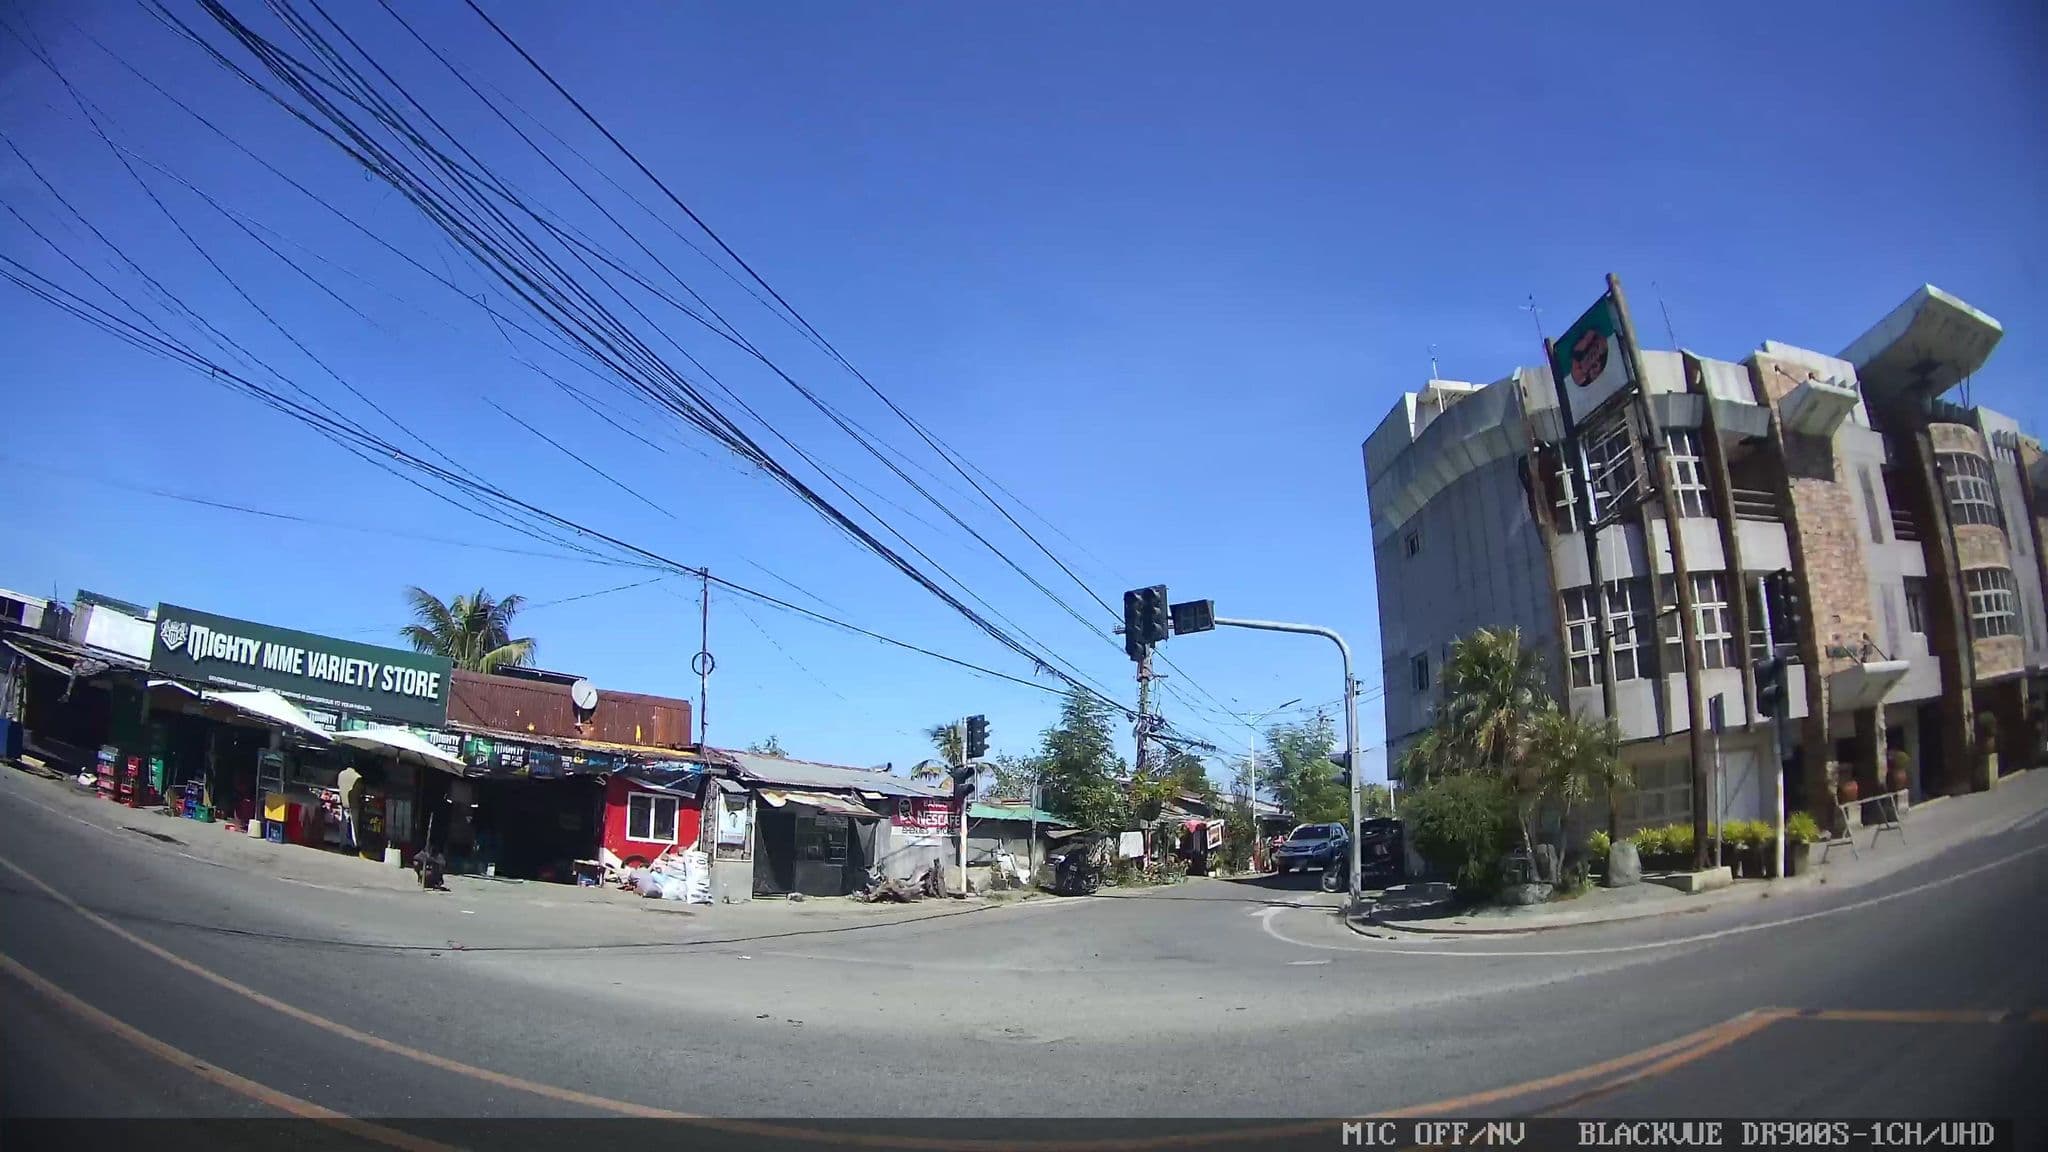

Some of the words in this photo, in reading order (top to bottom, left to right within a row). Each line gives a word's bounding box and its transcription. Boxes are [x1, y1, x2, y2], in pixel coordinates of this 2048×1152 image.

[187, 624, 262, 666] MIGHTY
[263, 642, 305, 675] MME
[307, 650, 380, 688] VARIETY
[381, 664, 441, 699] STORE
[494, 742, 525, 755] MIGHTY
